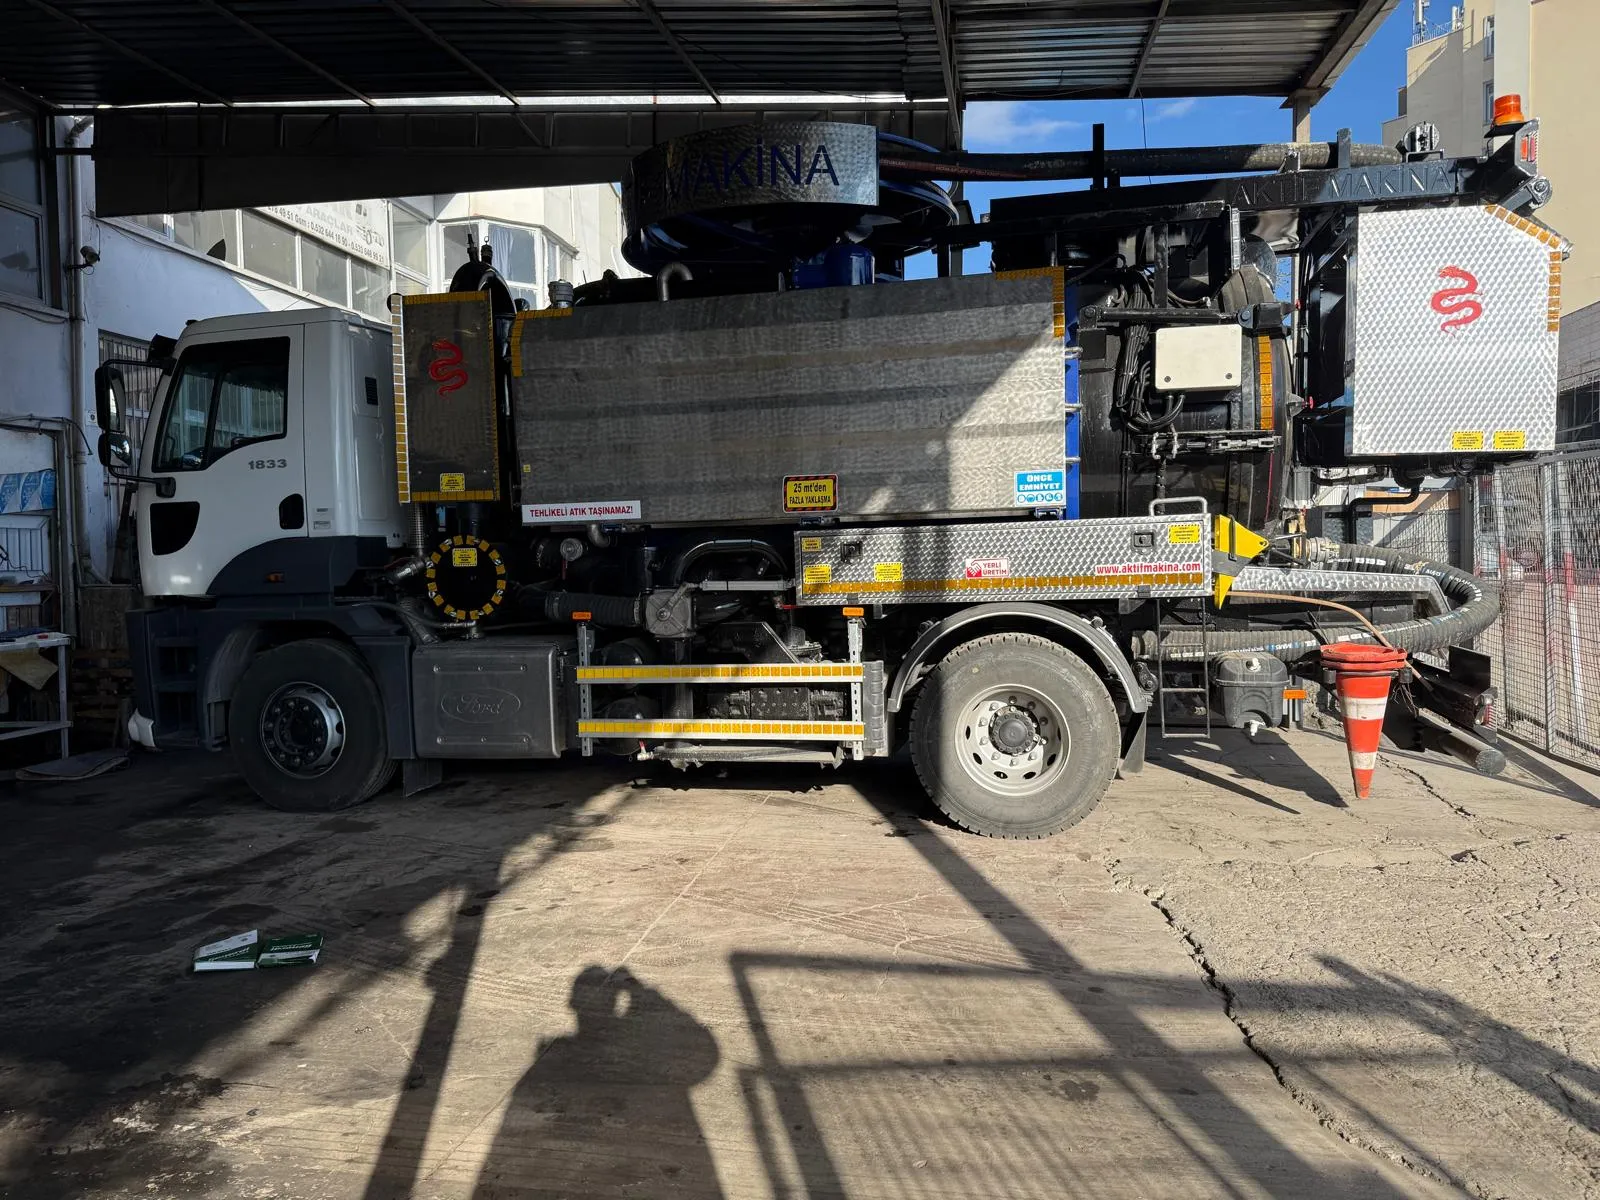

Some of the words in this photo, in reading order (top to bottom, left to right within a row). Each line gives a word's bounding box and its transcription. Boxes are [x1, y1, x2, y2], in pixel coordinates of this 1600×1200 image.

[248, 459, 287, 470] 1833
[793, 483, 802, 493] 25
[803, 482, 827, 493] mt'den
[789, 496, 804, 505] FAZLA
[530, 506, 567, 517] TEHLİKELİ
[569, 506, 587, 516] ATIK
[588, 505, 634, 517] TAŞINAMAZ!
[1096, 562, 1201, 575] www.aktifmakina.com
